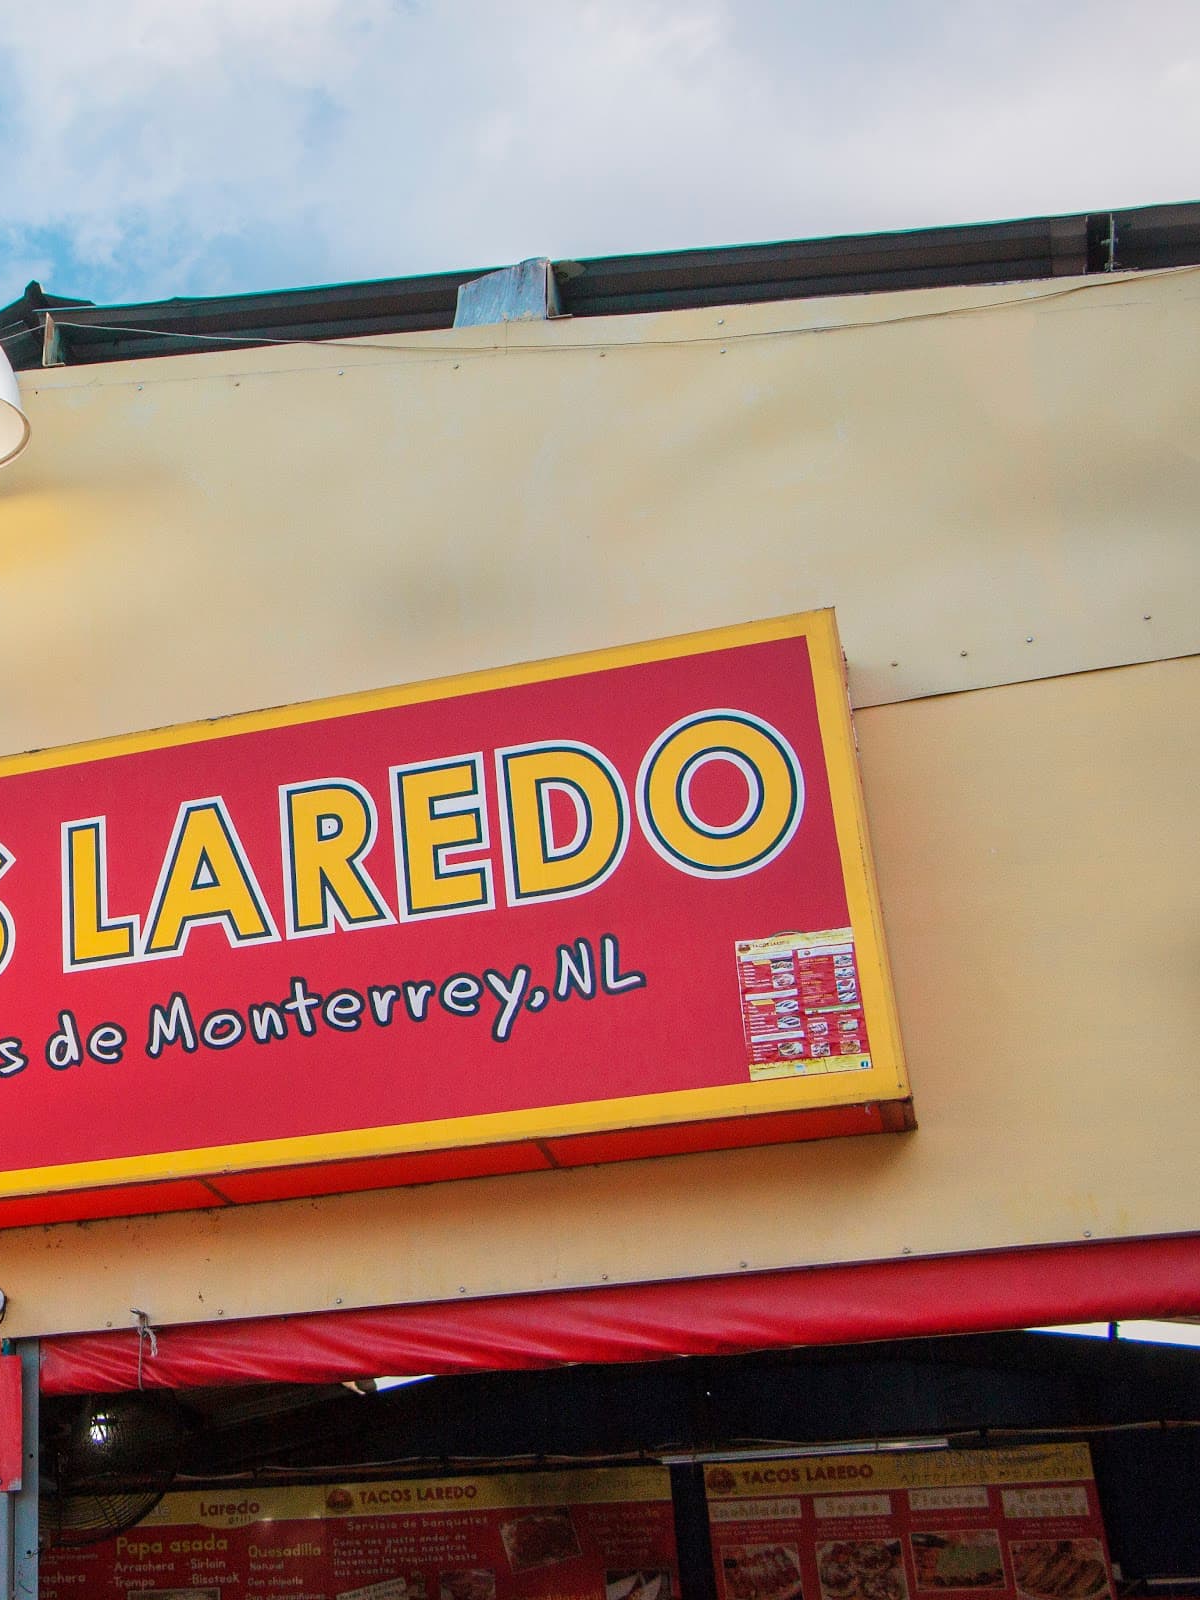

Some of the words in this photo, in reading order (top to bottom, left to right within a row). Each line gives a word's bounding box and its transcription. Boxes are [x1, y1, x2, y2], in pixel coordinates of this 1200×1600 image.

[60, 707, 805, 974] LAREDO
[44, 1007, 125, 1071] de
[742, 1467, 801, 1485] TACOS
[805, 1464, 874, 1482] LAREDO
[359, 1489, 412, 1505] TACOS
[416, 1485, 478, 1502] LAREDO
[199, 1500, 260, 1516] Laredo
[402, 1519, 418, 1529] de
[115, 1536, 163, 1560] Papa
[168, 1532, 229, 1553] asada
[248, 1542, 321, 1559] Quesadilla
